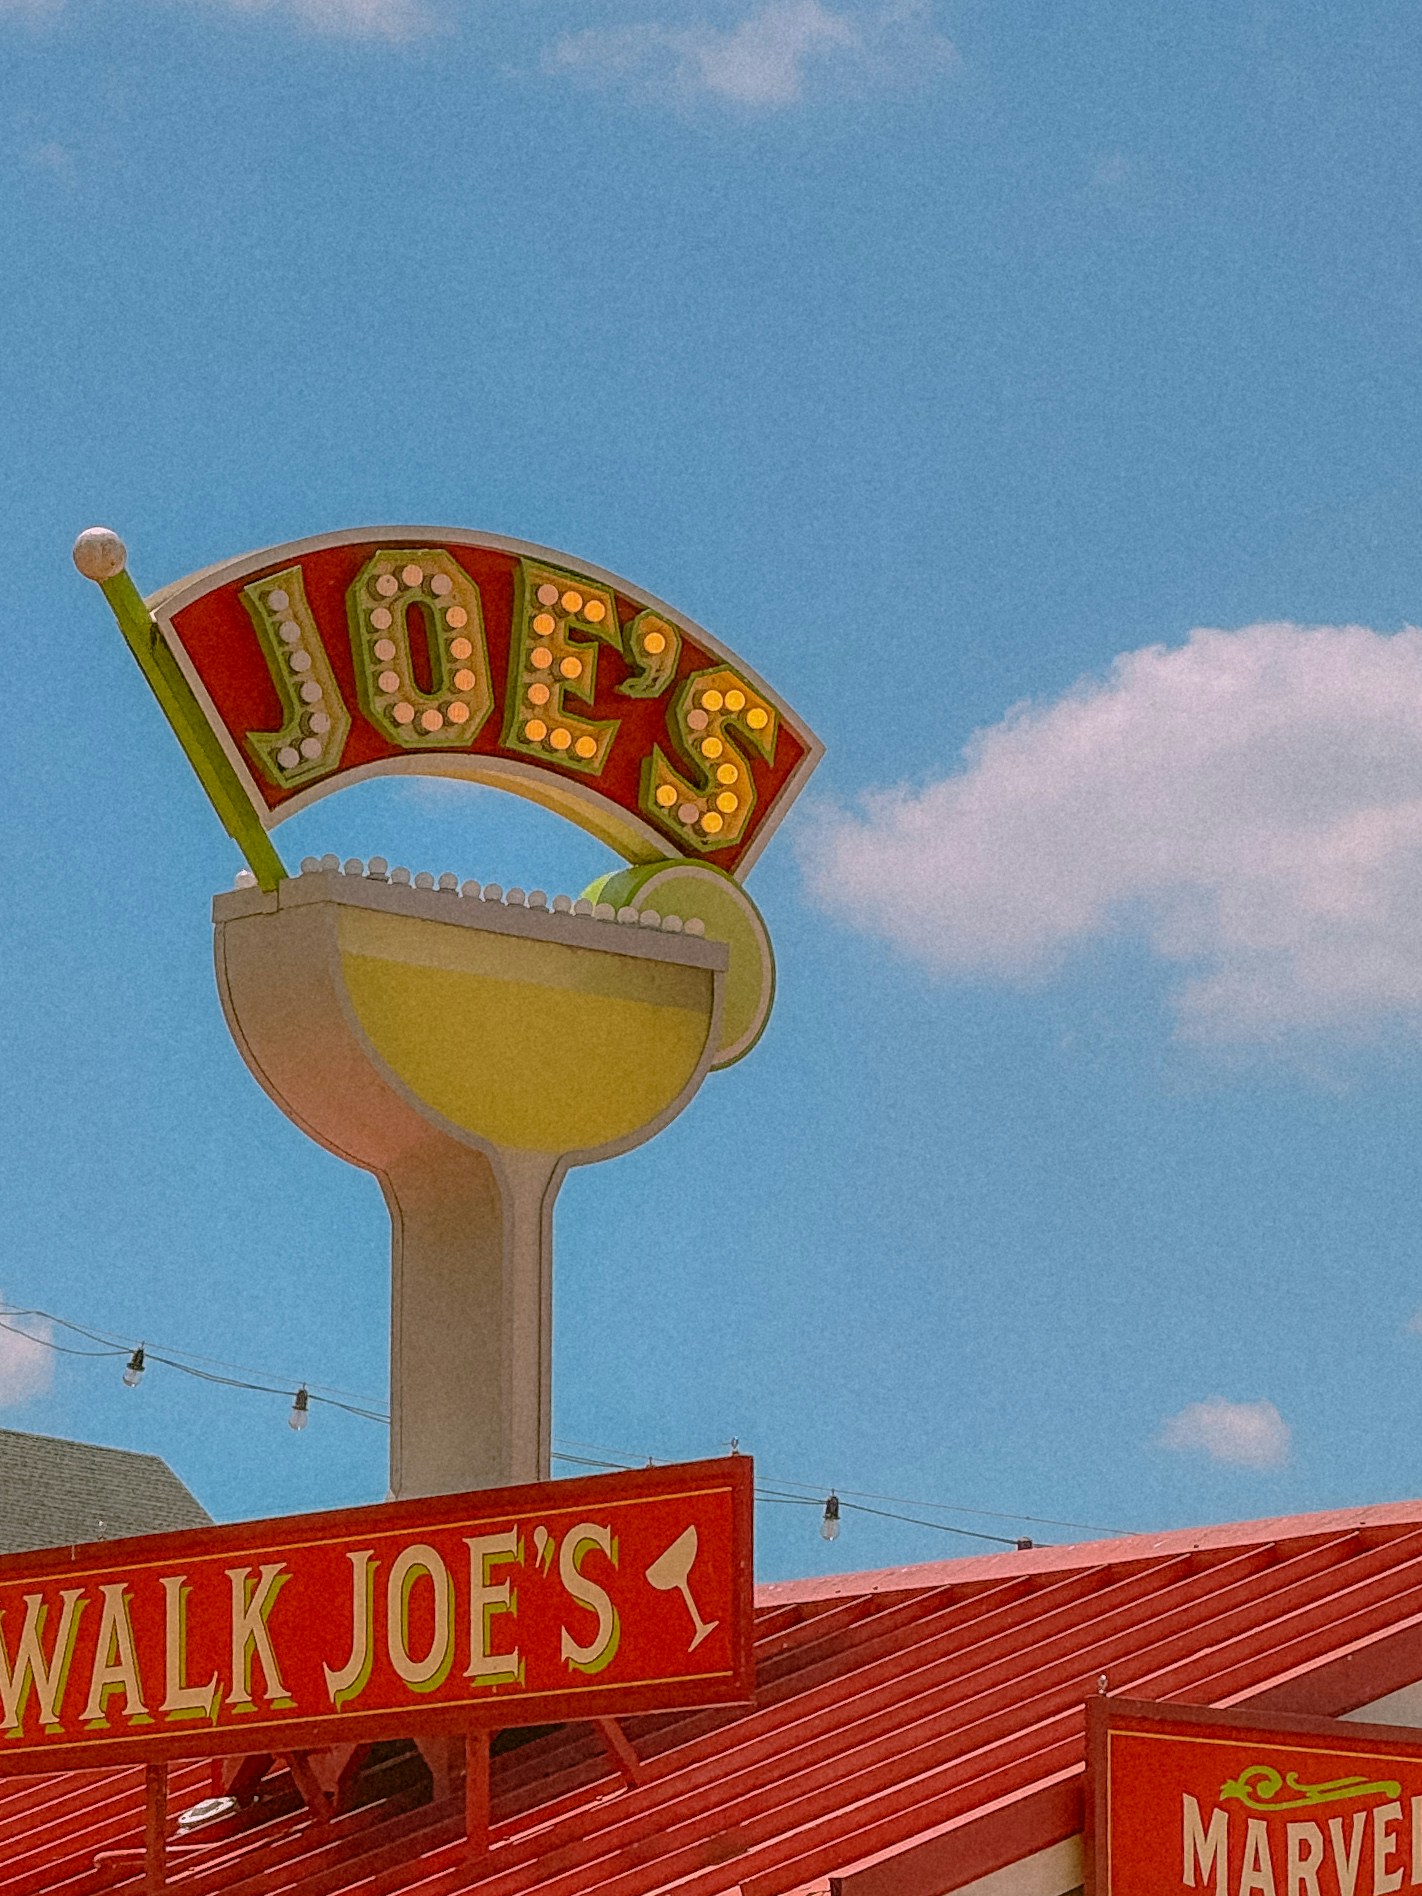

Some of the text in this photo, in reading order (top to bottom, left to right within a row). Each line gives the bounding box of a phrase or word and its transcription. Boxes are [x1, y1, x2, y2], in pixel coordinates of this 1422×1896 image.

[240, 548, 779, 853] JOE'S
[0, 1522, 620, 1737] WALK JOE'S
